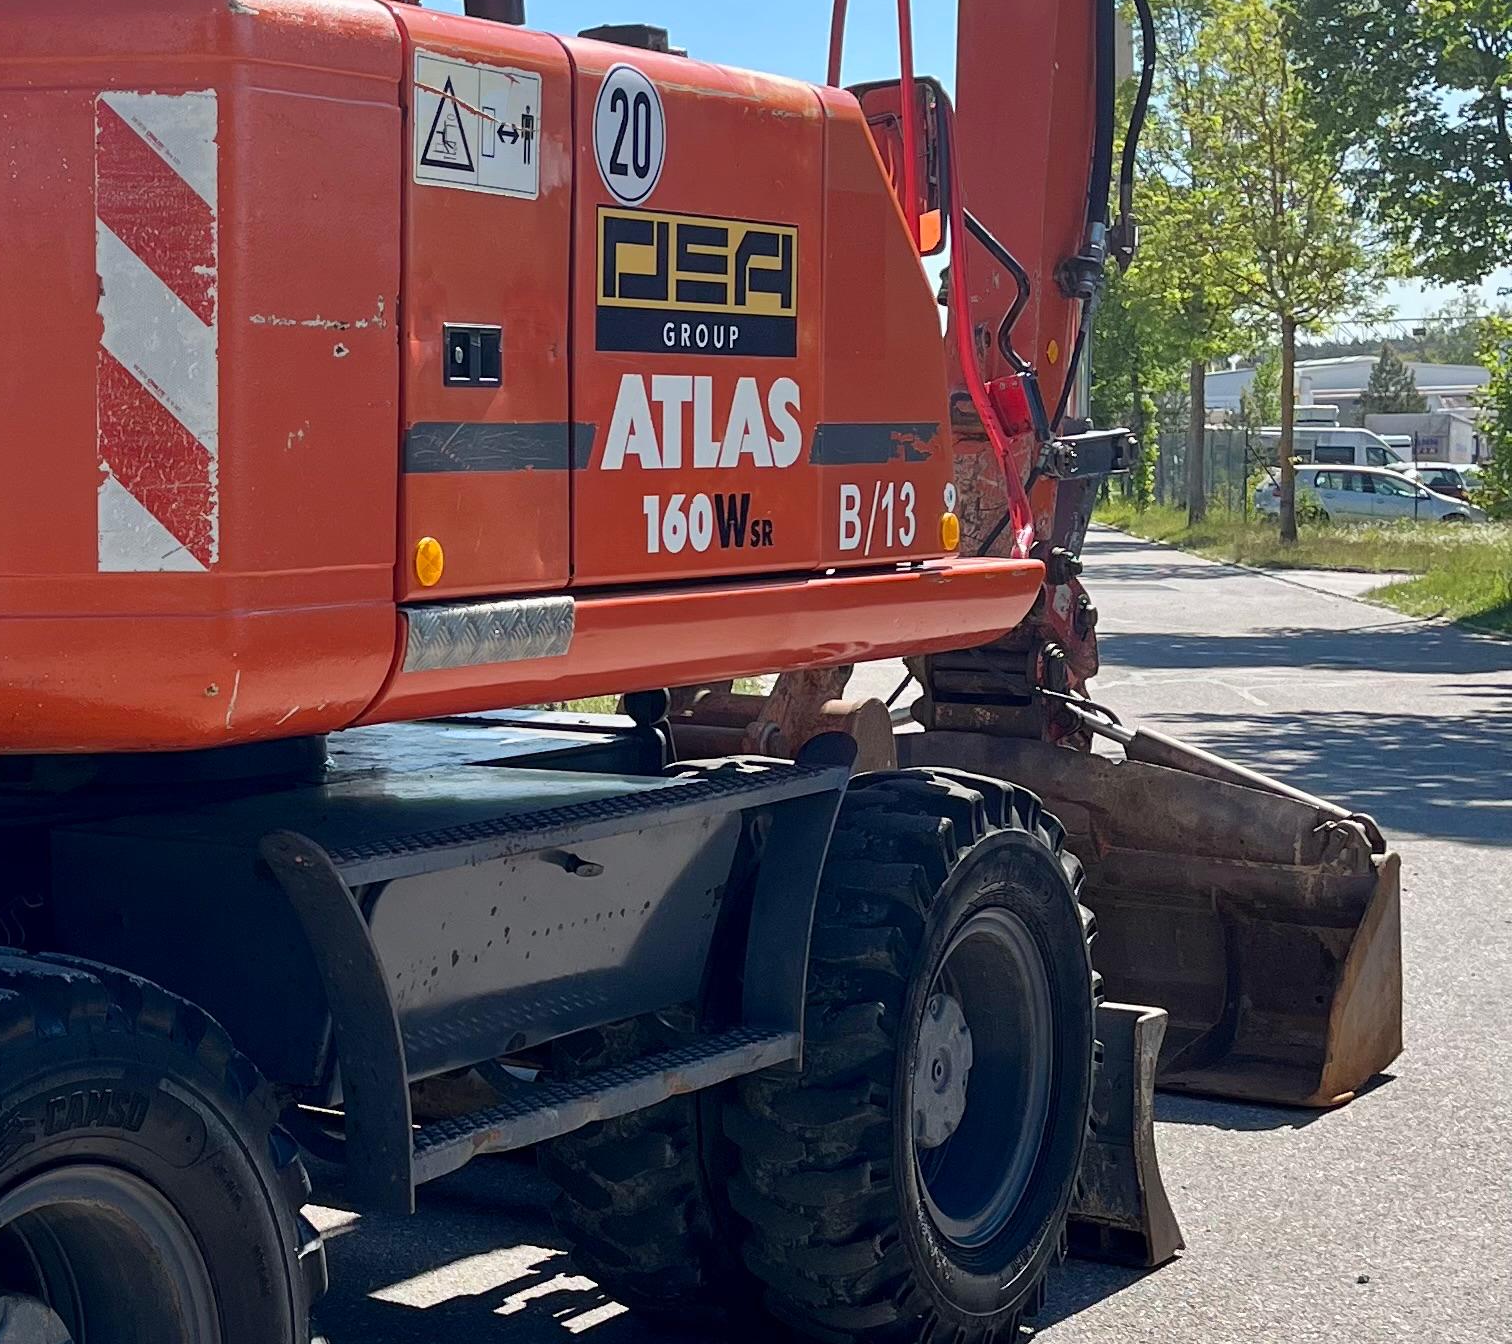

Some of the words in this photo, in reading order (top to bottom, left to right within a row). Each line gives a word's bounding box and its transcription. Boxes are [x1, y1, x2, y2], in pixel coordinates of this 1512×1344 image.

[609, 86, 651, 179] 20
[662, 321, 740, 349] GROUP
[601, 373, 802, 470] ATLAS
[839, 480, 916, 556] B/13
[44, 1088, 150, 1136] CAMSO
